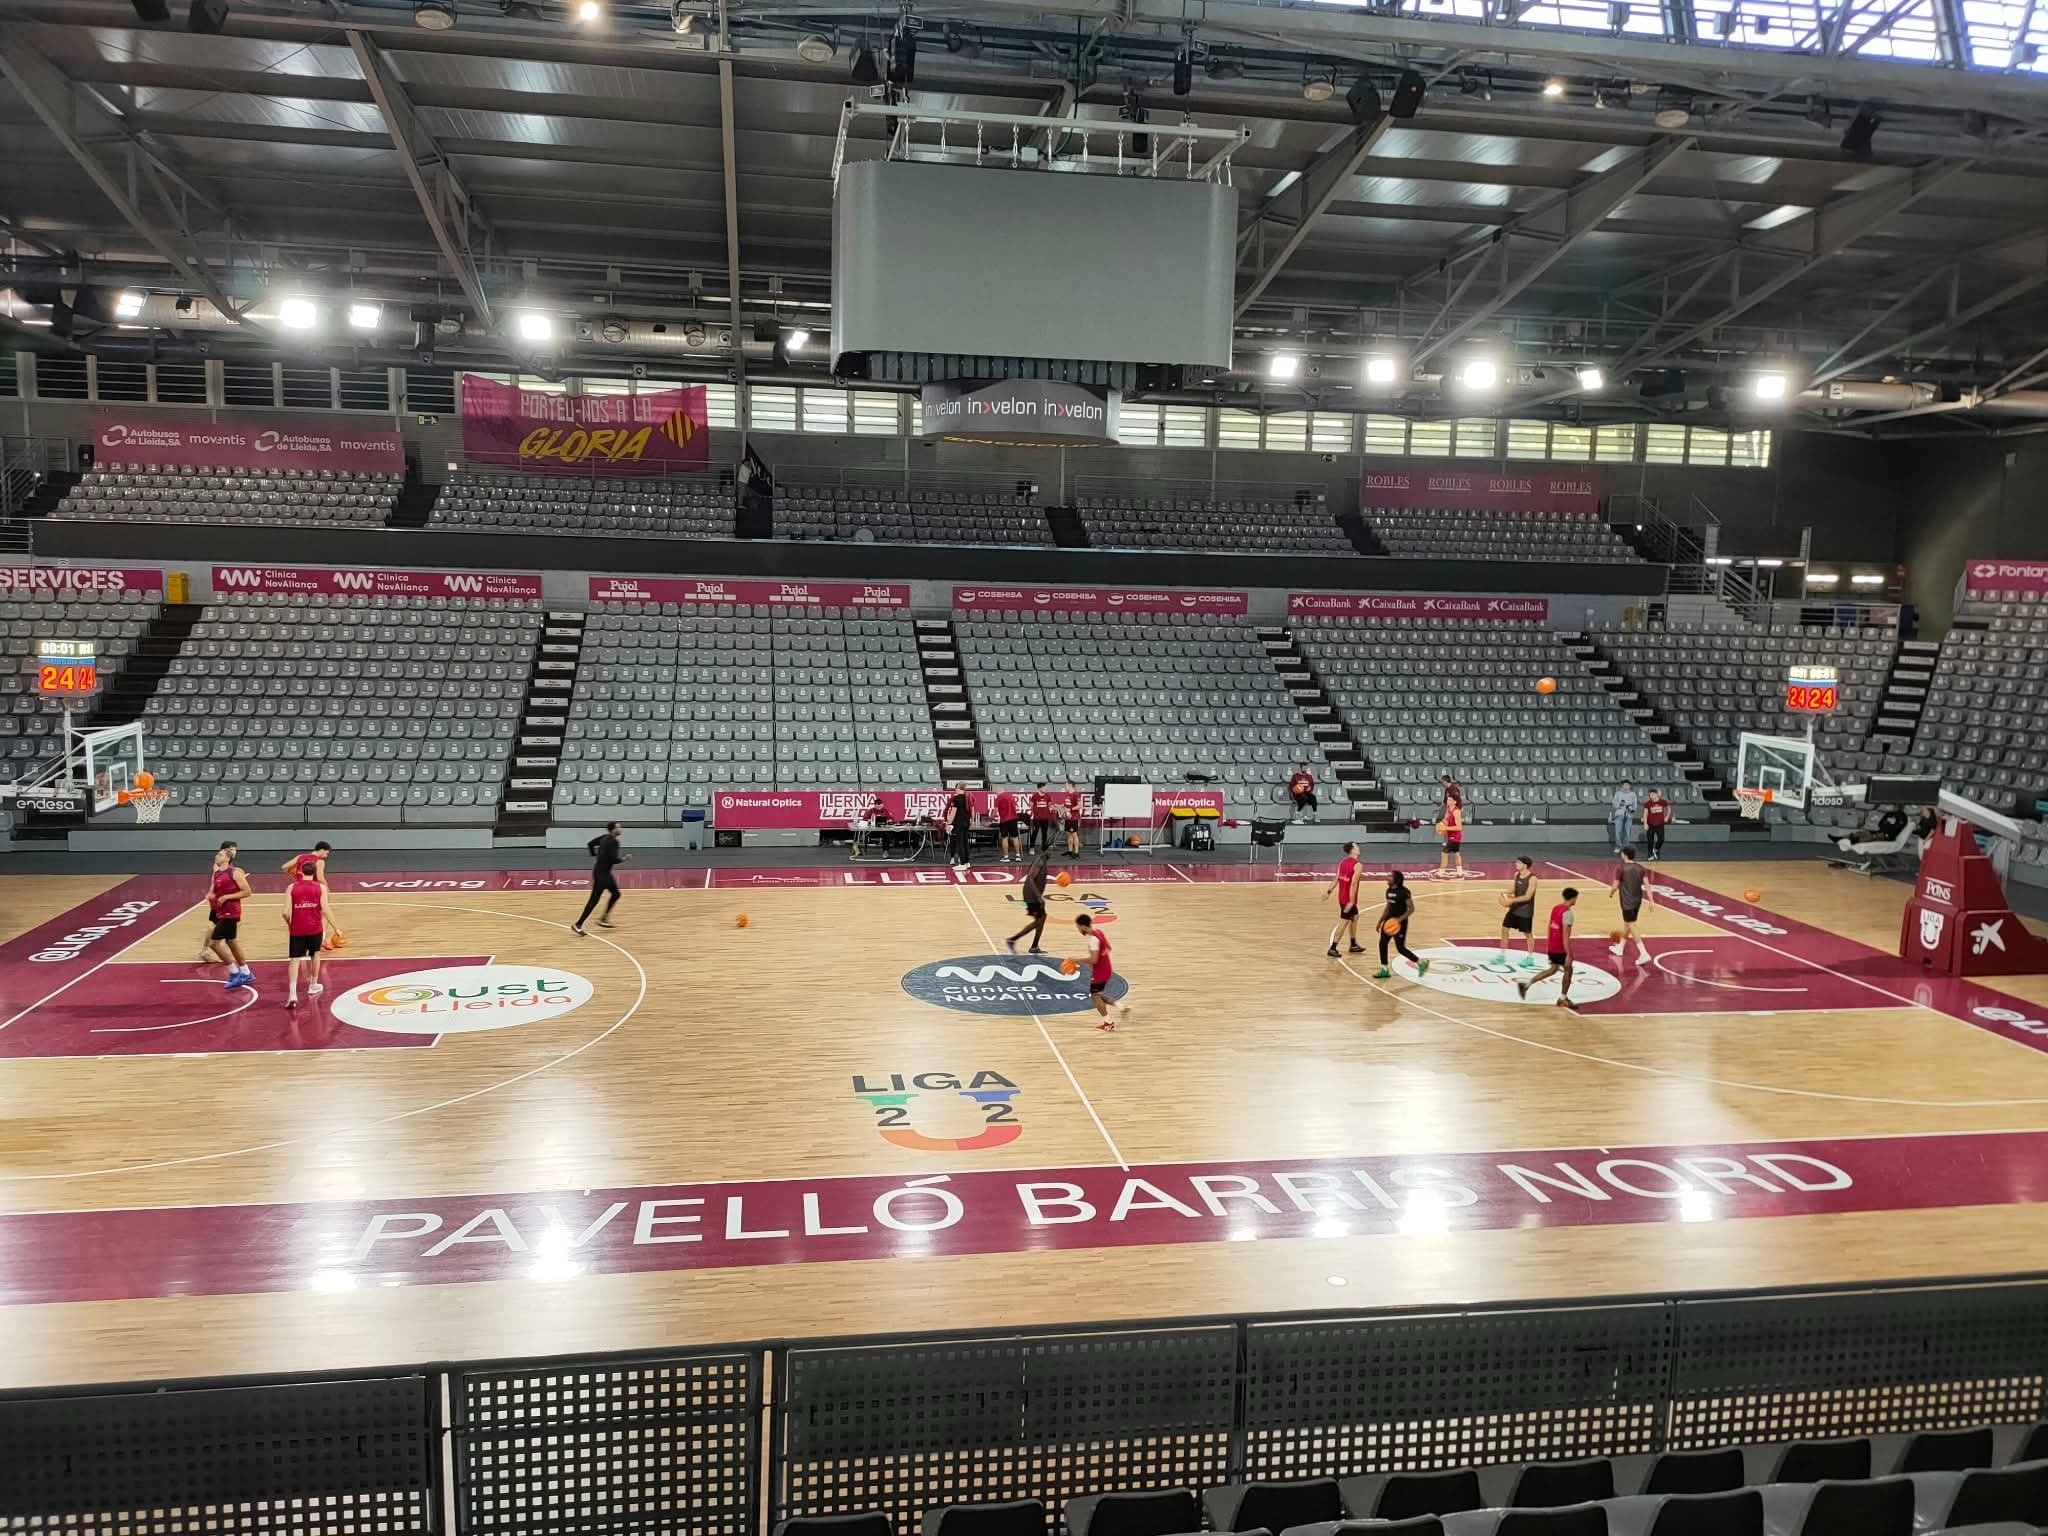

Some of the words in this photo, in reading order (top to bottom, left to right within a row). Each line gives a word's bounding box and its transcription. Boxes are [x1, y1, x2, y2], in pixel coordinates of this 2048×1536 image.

[130, 429, 180, 438] Autobusos
[189, 433, 246, 446] moventis
[282, 434, 331, 444] Autobusos
[340, 439, 396, 452] moventis
[265, 580, 318, 590] NovAliança
[377, 583, 429, 593] NovAliança
[486, 585, 537, 595] NovAliança
[610, 580, 639, 592] Pujol
[696, 582, 724, 595] Pujol
[780, 584, 809, 596] Pujol
[863, 586, 891, 598] Pujol
[1305, 599, 1352, 609] CaixaBank
[1371, 600, 1417, 610] CaixaBank
[1436, 601, 1481, 611] CaixaBank
[1500, 601, 1545, 612] CaixaBank
[42, 666, 74, 690] 24
[79, 667, 94, 689] 24
[1809, 688, 1833, 708] 24
[16, 799, 75, 811] endesa
[735, 798, 770, 808] Natural
[771, 798, 802, 808] Optics
[1155, 798, 1187, 807] Natural
[1187, 798, 1216, 808] Optics
[359, 879, 486, 889] viding
[1926, 879, 1952, 901] PONS
[944, 993, 1091, 1003] NovAlianç
[420, 995, 573, 1014] Lleida
[852, 1070, 1018, 1093] LIGA
[875, 1107, 912, 1127] 2
[981, 1103, 1019, 1123] 2
[352, 1174, 964, 1264] PAVELLÓ
[1014, 1165, 1478, 1226] BARRIS
[1498, 1152, 1856, 1205] NORD
